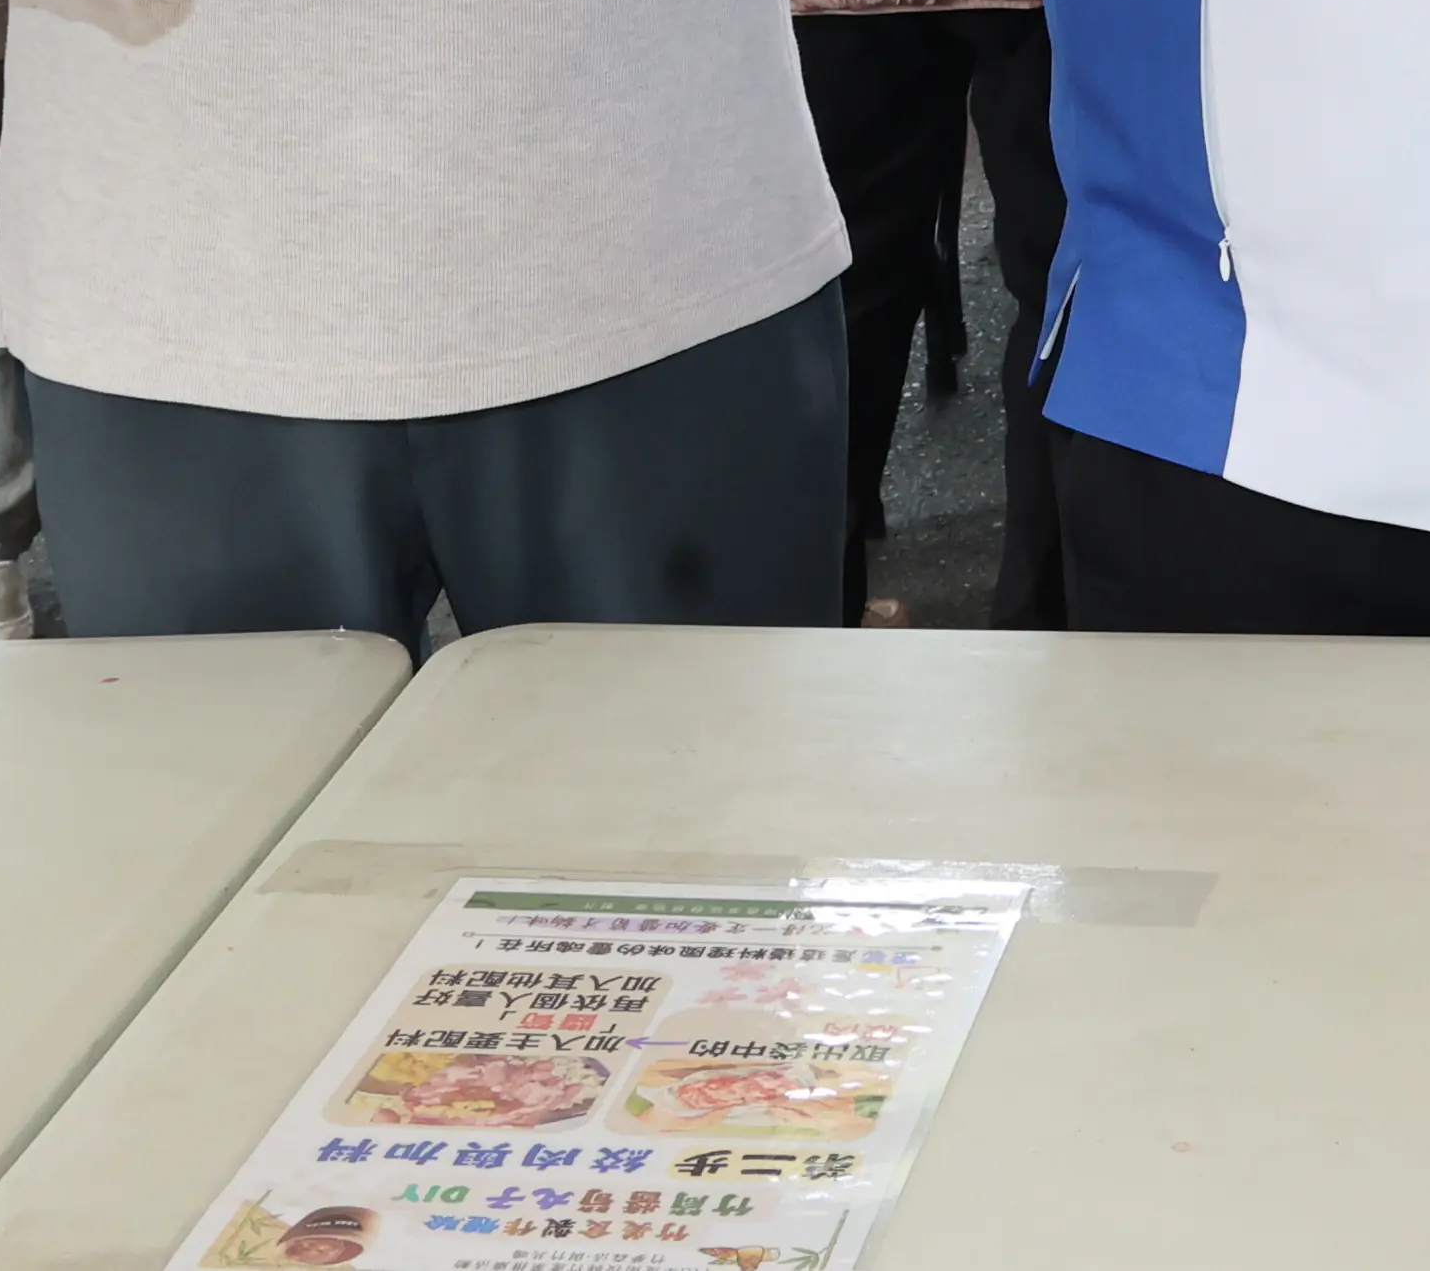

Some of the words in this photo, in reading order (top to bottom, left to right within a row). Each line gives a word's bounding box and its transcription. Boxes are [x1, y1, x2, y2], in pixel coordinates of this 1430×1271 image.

[430, 968, 662, 992] 加入其他配料
[413, 988, 650, 1013] 再依個人喜好
[385, 1028, 627, 1053] 加入主要配料
[688, 1039, 892, 1063] 取出袋中的
[316, 1136, 655, 1175] 絞肉與加料
[674, 1148, 857, 1181] 第二步
[392, 1183, 471, 1205] DIY
